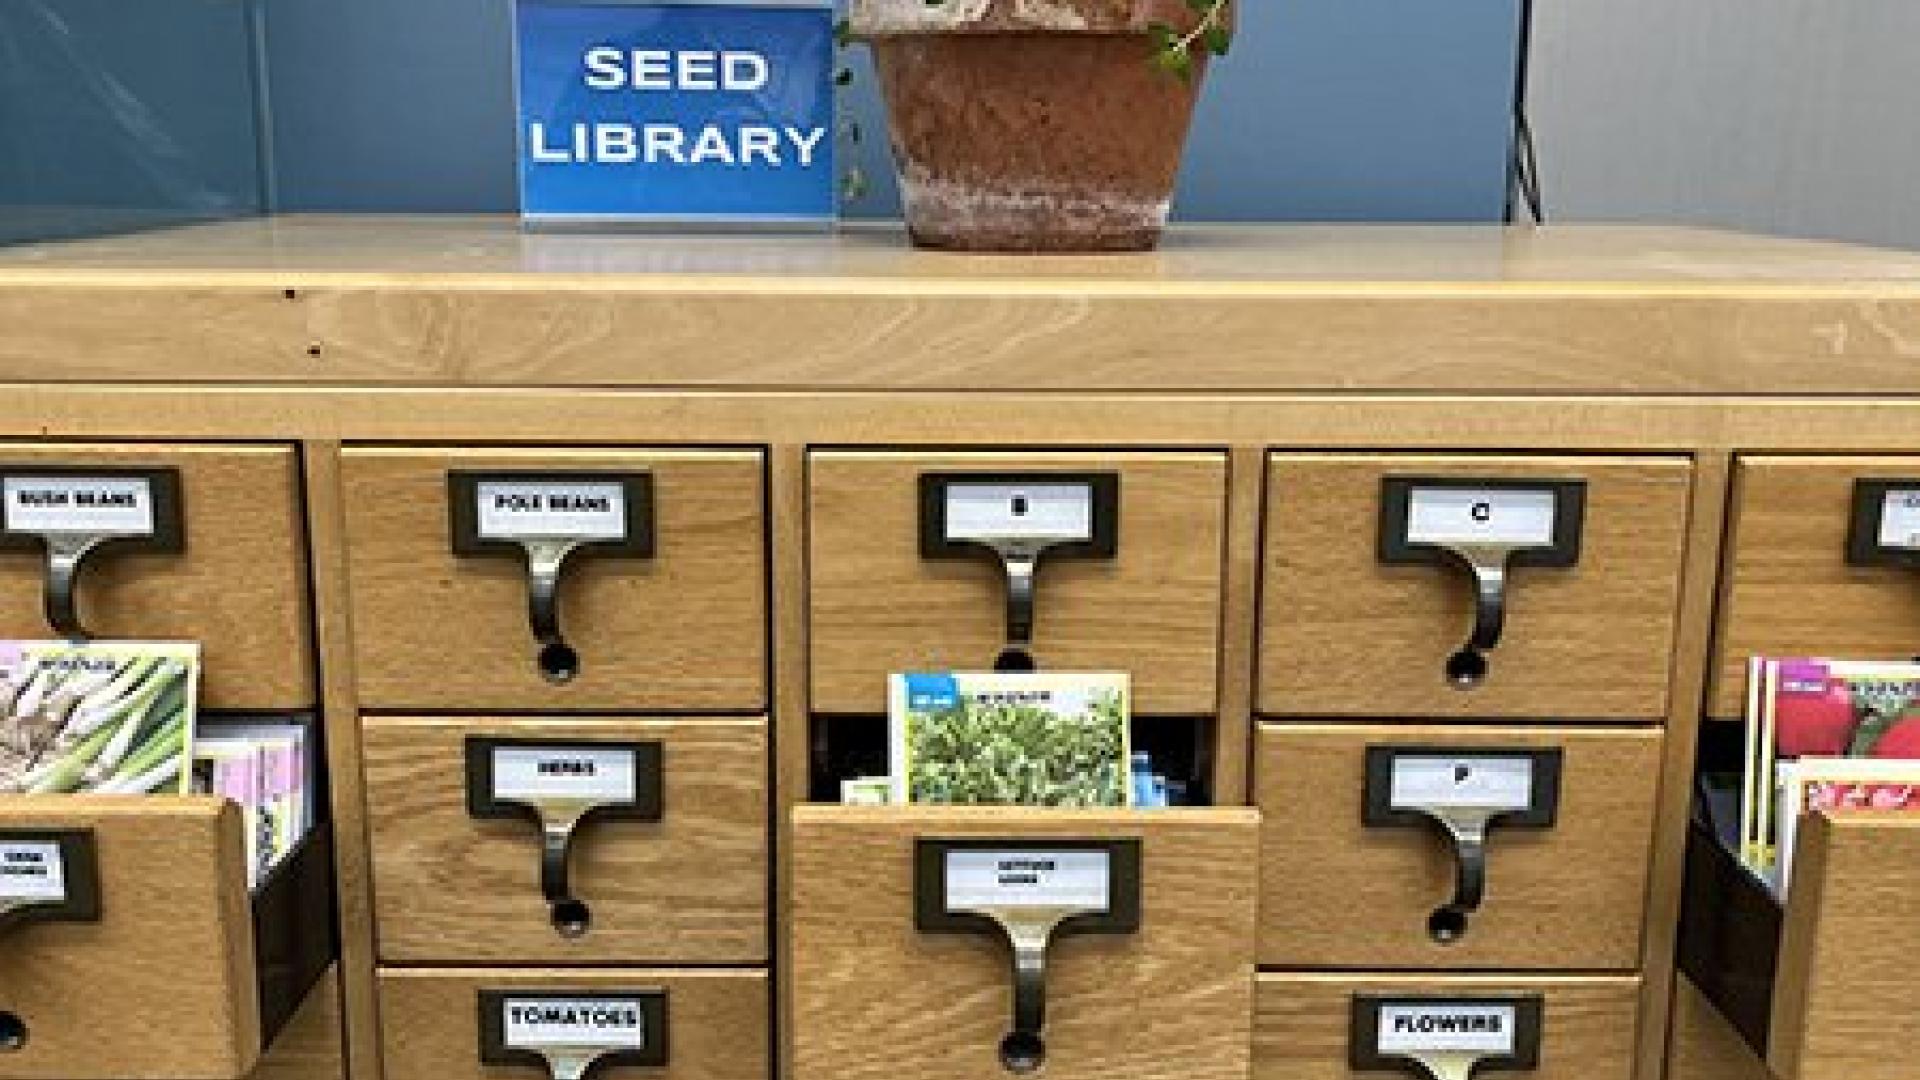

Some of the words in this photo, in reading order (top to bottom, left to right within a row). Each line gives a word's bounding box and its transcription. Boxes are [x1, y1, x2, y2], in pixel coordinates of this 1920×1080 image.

[584, 47, 768, 90] SEED
[530, 122, 826, 166] LIBRARY
[18, 490, 68, 507] BUSH
[74, 490, 137, 508] BEANS
[494, 494, 542, 512] POLE
[550, 494, 610, 512] BEANS
[1010, 495, 1028, 516] B
[1472, 502, 1490, 524] C
[537, 759, 596, 776] HERBS
[1454, 764, 1472, 785] P
[511, 1006, 637, 1028] TOMATOES
[1394, 1014, 1503, 1033] FLOWERS
